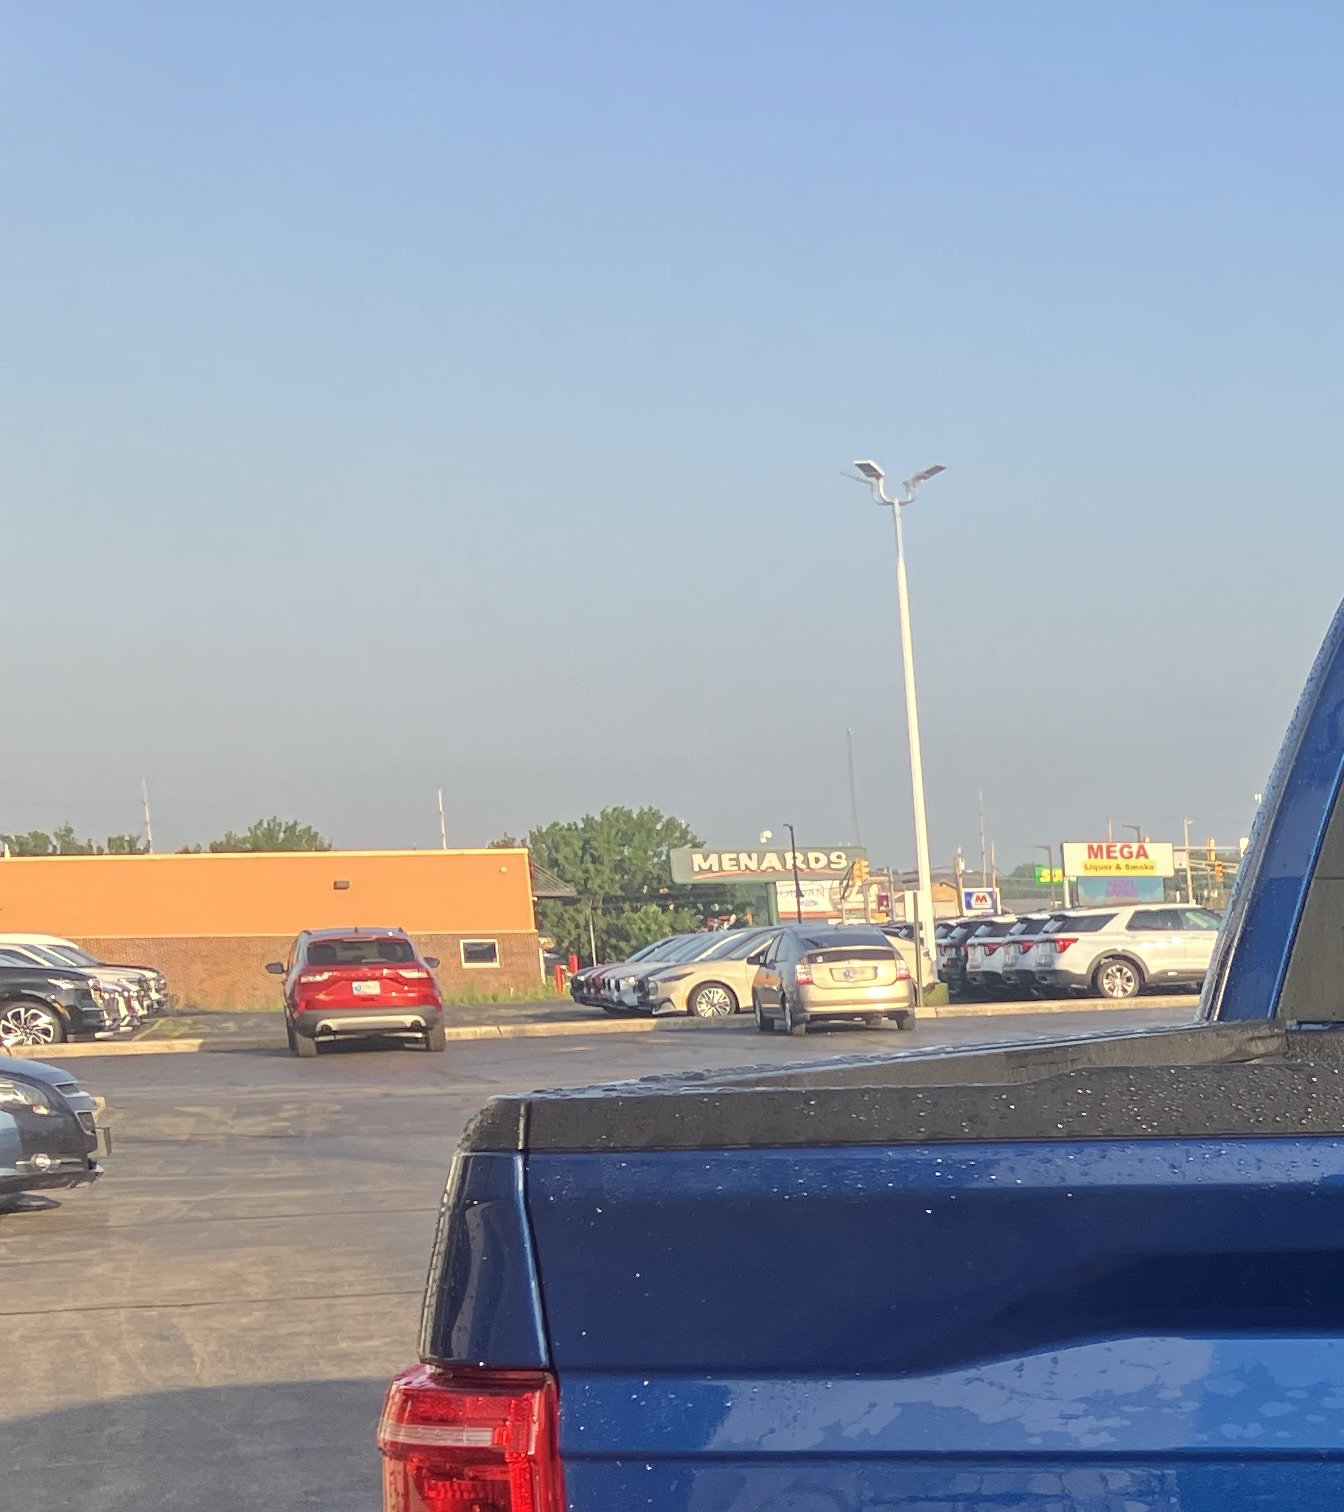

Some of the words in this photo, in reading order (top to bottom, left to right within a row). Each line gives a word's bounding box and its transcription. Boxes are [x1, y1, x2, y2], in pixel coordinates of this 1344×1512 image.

[1087, 844, 1149, 860] MEGA
[692, 851, 848, 872] MENARDS
[1084, 864, 1113, 872] Liquor
